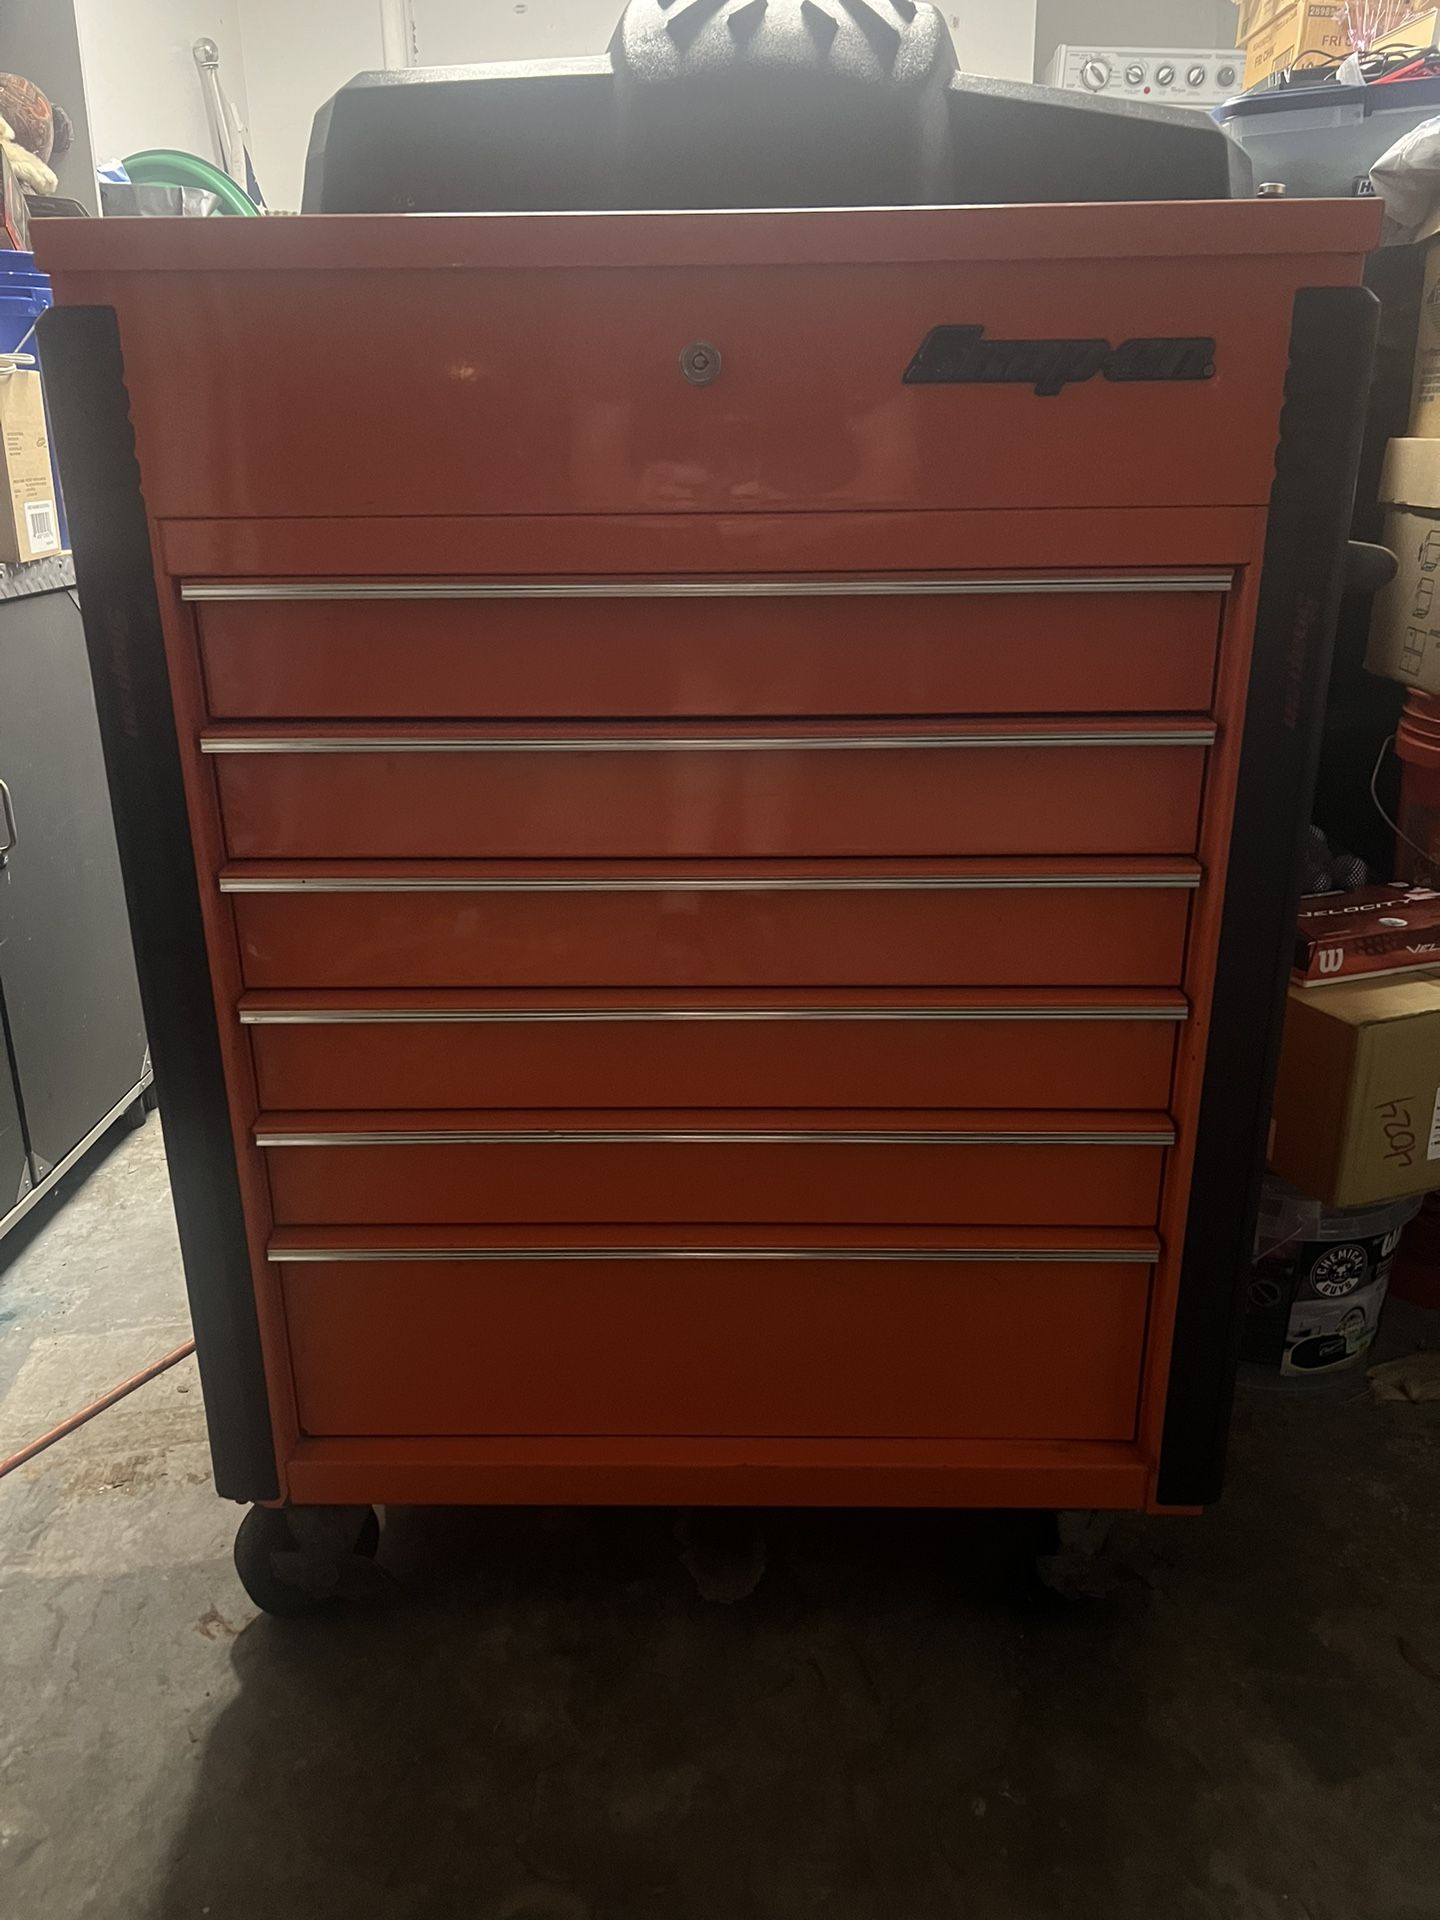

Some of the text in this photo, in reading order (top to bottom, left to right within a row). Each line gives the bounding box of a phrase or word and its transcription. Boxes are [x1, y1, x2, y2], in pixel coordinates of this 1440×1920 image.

[1374, 1095, 1416, 1167] 4024
[1316, 1248, 1363, 1275] CHEMICAL
[1322, 1280, 1352, 1295] GUYS
